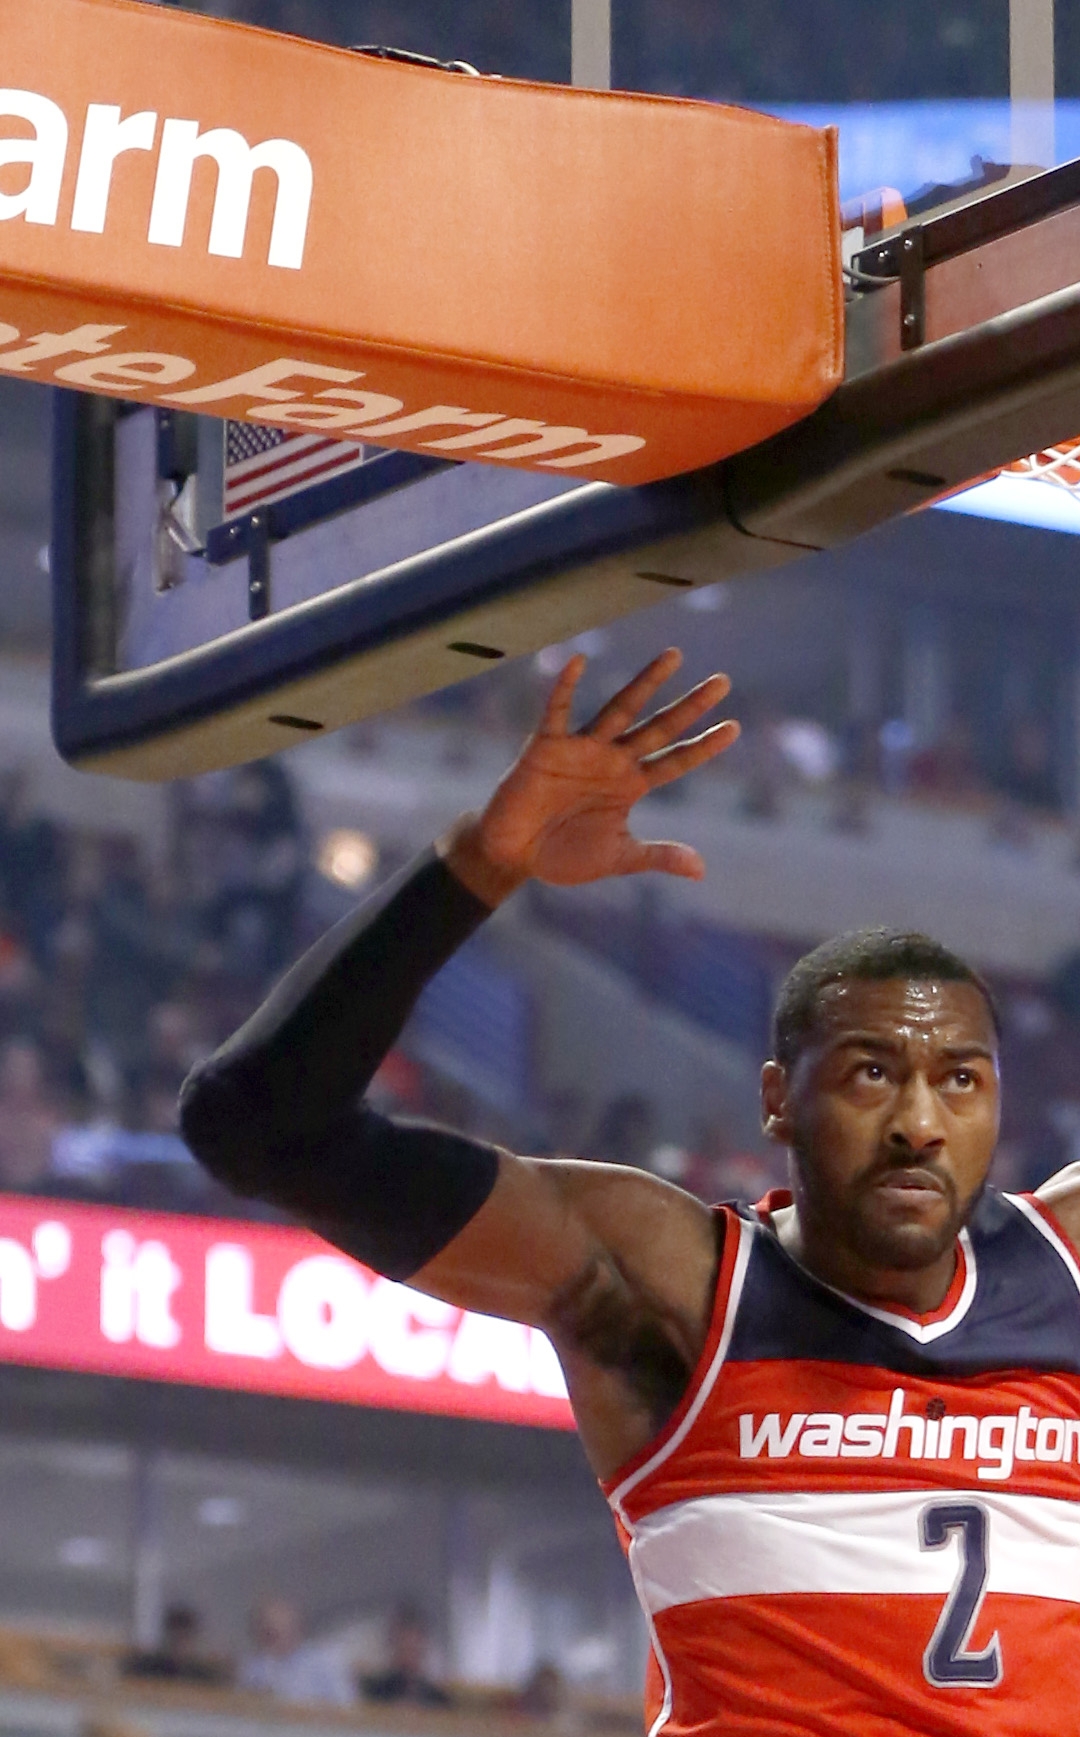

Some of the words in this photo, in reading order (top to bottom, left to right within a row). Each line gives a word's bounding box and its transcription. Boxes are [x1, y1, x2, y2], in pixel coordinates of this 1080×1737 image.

[158, 358, 647, 469] Farm
[101, 1229, 181, 1348] it
[918, 1500, 1004, 1689] 2
